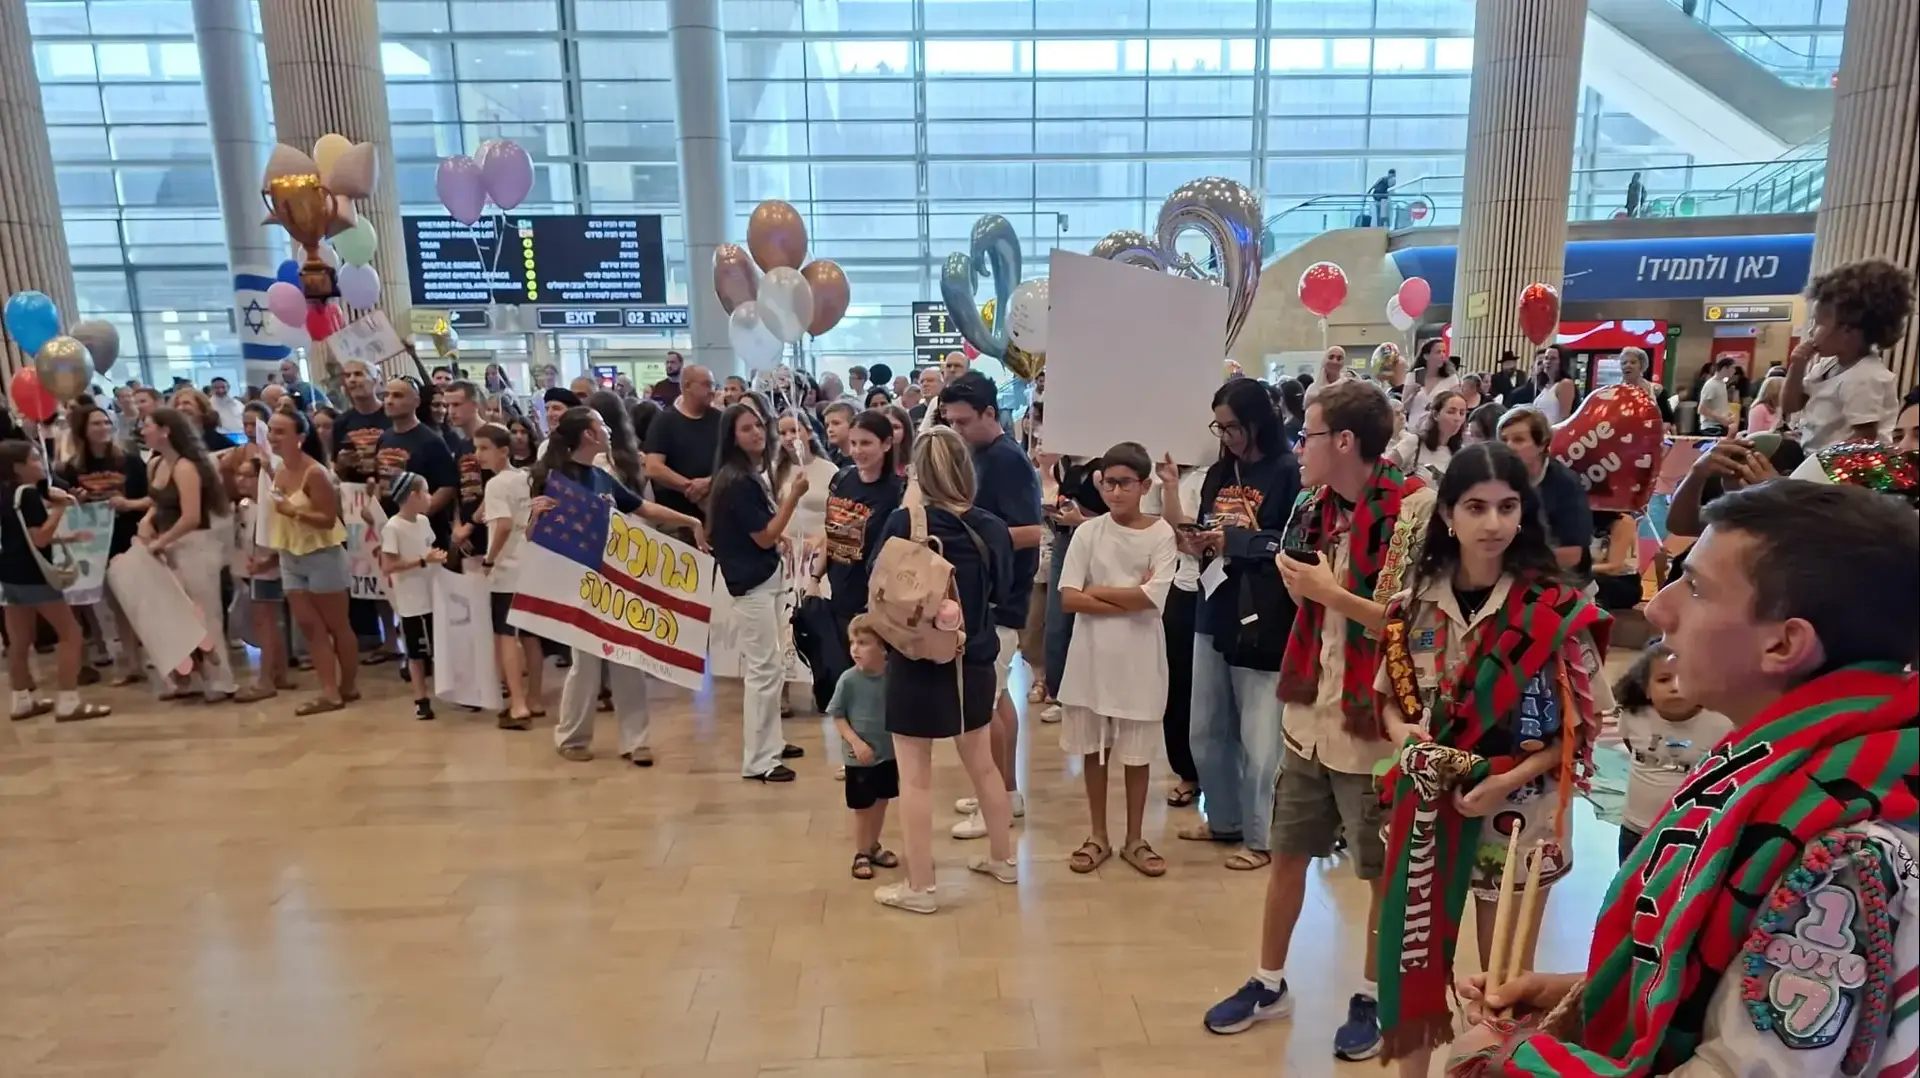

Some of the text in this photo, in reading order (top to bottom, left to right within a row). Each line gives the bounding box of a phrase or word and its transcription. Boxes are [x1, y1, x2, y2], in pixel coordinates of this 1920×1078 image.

[1637, 254, 1779, 283] כאן ולתמיד!
[565, 311, 597, 324] EXIT
[627, 312, 686, 324] 02 יציאה
[606, 512, 699, 594] ברוכה
[580, 571, 679, 646] השווה
[1400, 807, 1438, 973] EMPIRE
